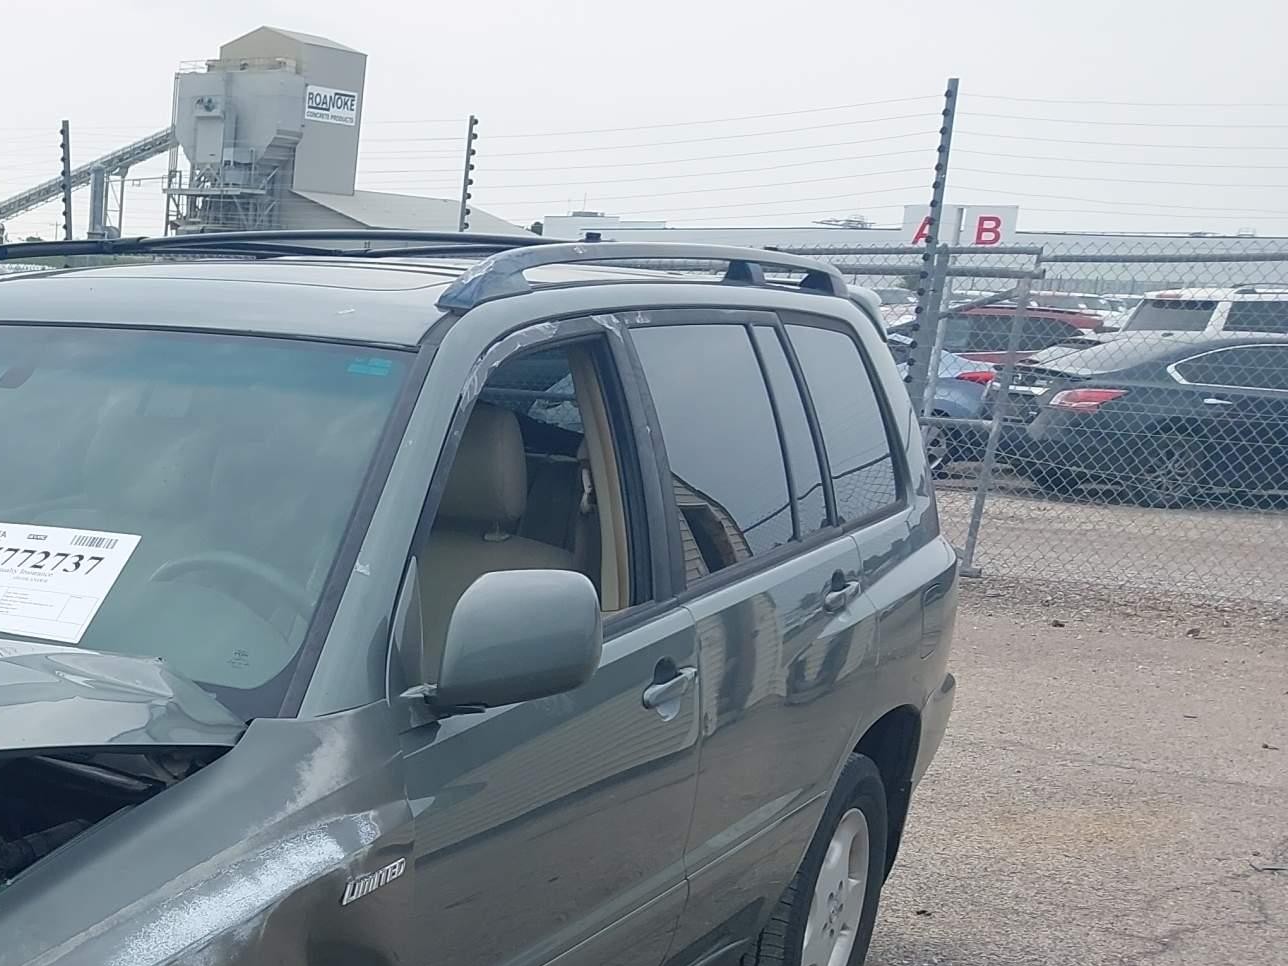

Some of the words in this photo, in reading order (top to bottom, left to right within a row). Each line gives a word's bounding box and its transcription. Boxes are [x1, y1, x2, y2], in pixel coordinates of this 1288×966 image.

[308, 92, 355, 112] ROANOKE
[975, 216, 1002, 245] B
[341, 857, 406, 906] LIMITED
